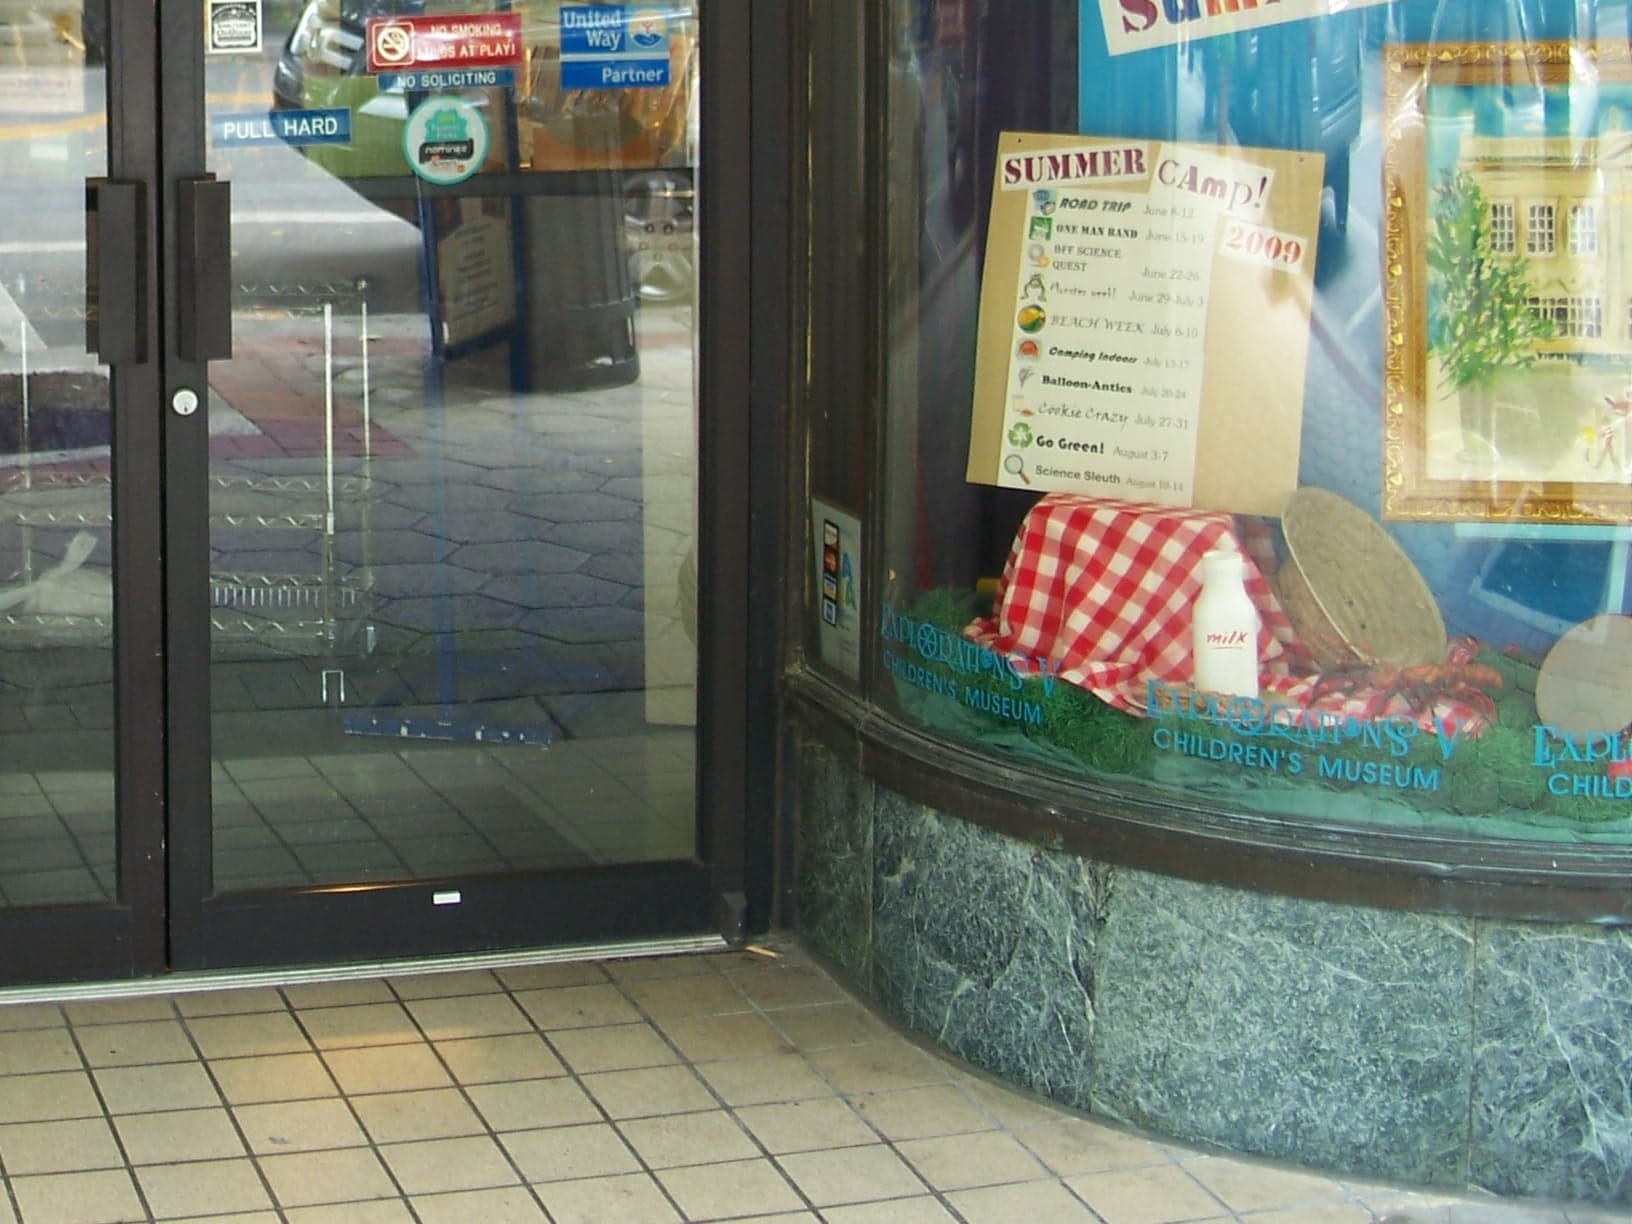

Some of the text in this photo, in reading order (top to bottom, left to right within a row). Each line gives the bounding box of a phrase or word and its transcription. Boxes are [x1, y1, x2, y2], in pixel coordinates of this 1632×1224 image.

[563, 11, 621, 28] United
[430, 22, 502, 37] NO SMOKING
[587, 30, 621, 51] Way
[460, 44, 474, 58] AT
[480, 43, 516, 56] PLAY!
[397, 73, 496, 88] NO SOLICITING
[601, 67, 664, 84] Partner
[224, 116, 338, 140] PULL HARD
[1004, 148, 1146, 184] SUMMER
[1060, 198, 1098, 210] ROAD
[1102, 200, 1132, 213] TRIP
[1056, 224, 1079, 234] ONE
[1081, 226, 1104, 236] MAN
[1108, 228, 1138, 239] BAND
[1076, 246, 1122, 258] SCIENCE
[1227, 227, 1302, 265] 2009
[1052, 261, 1088, 272] QUEST
[1050, 315, 1099, 328] BEACH
[1104, 318, 1147, 334] WEEK
[1049, 347, 1096, 362] Camping
[1042, 375, 1132, 393] Balloon-Antics
[1036, 435, 1054, 448] Go
[1058, 438, 1105, 454] Green!
[1035, 465, 1081, 480] Science
[1084, 471, 1121, 484] Sleuth
[1206, 631, 1248, 645] milk
[1037, 656, 1061, 698] V
[884, 650, 1044, 725] CHILDREN'S MUSEUM
[1433, 714, 1462, 760] V
[1152, 728, 1440, 792] CHILDREN'S MUSEUM
